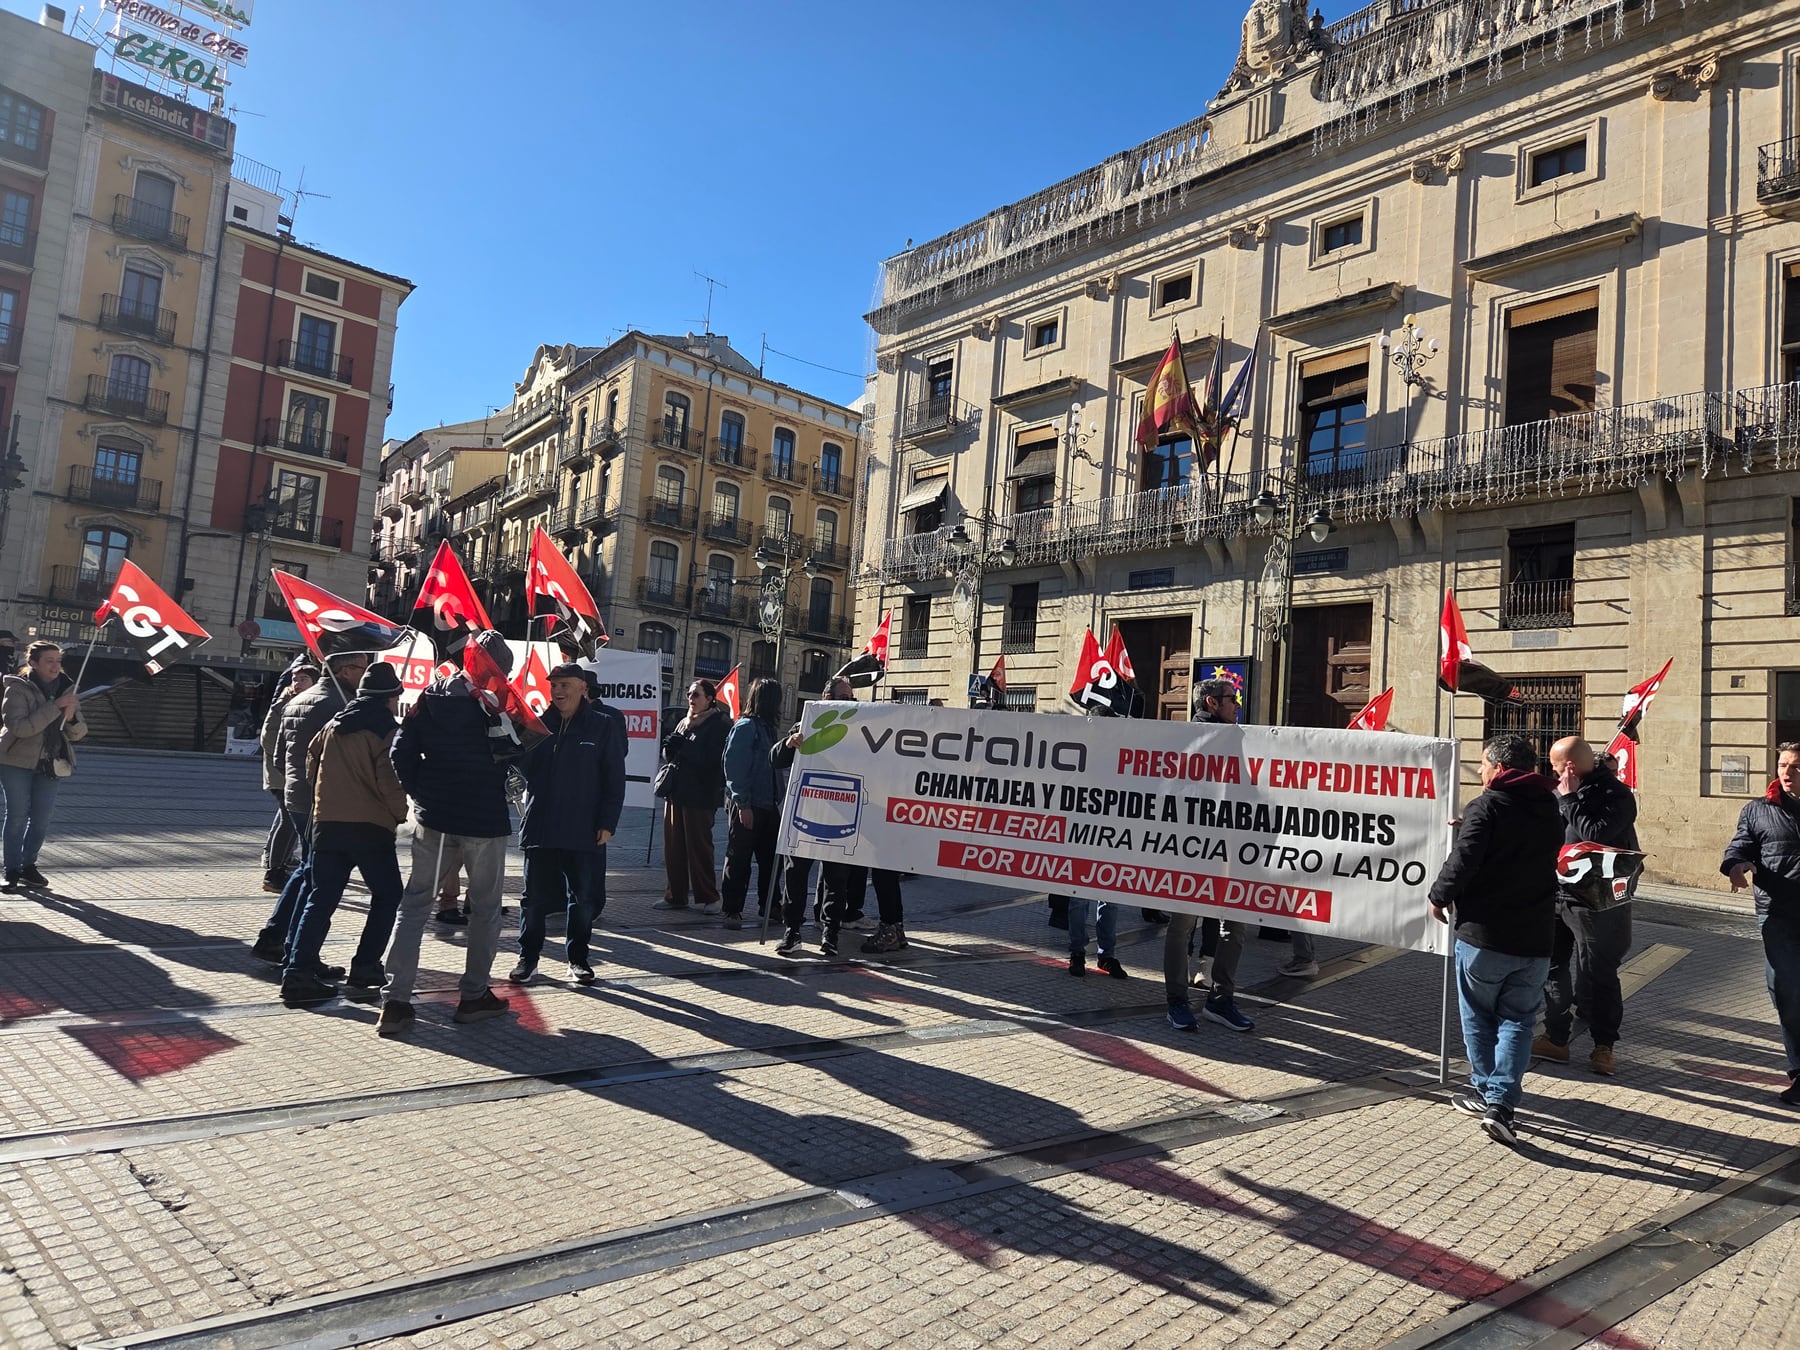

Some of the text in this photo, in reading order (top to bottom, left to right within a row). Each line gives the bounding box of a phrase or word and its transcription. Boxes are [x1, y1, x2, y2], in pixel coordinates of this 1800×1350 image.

[181, 24, 199, 40] de
[115, 33, 223, 92] CEROL
[123, 91, 189, 129] Icelandic
[45, 606, 84, 622] ideal
[861, 726, 1088, 773] vectalia
[1117, 748, 1436, 800] PRESIONA Y EXPEDIENTA
[801, 787, 857, 804] INTERURBANO
[915, 771, 1396, 846] CHANTAJEA Y DESPIDE A TRABAJADORES
[892, 802, 1427, 886] CONSELLERÍA MIRA HACIA OTRO LADO
[960, 845, 1319, 916] POR UNA JORNADA DIGNA
